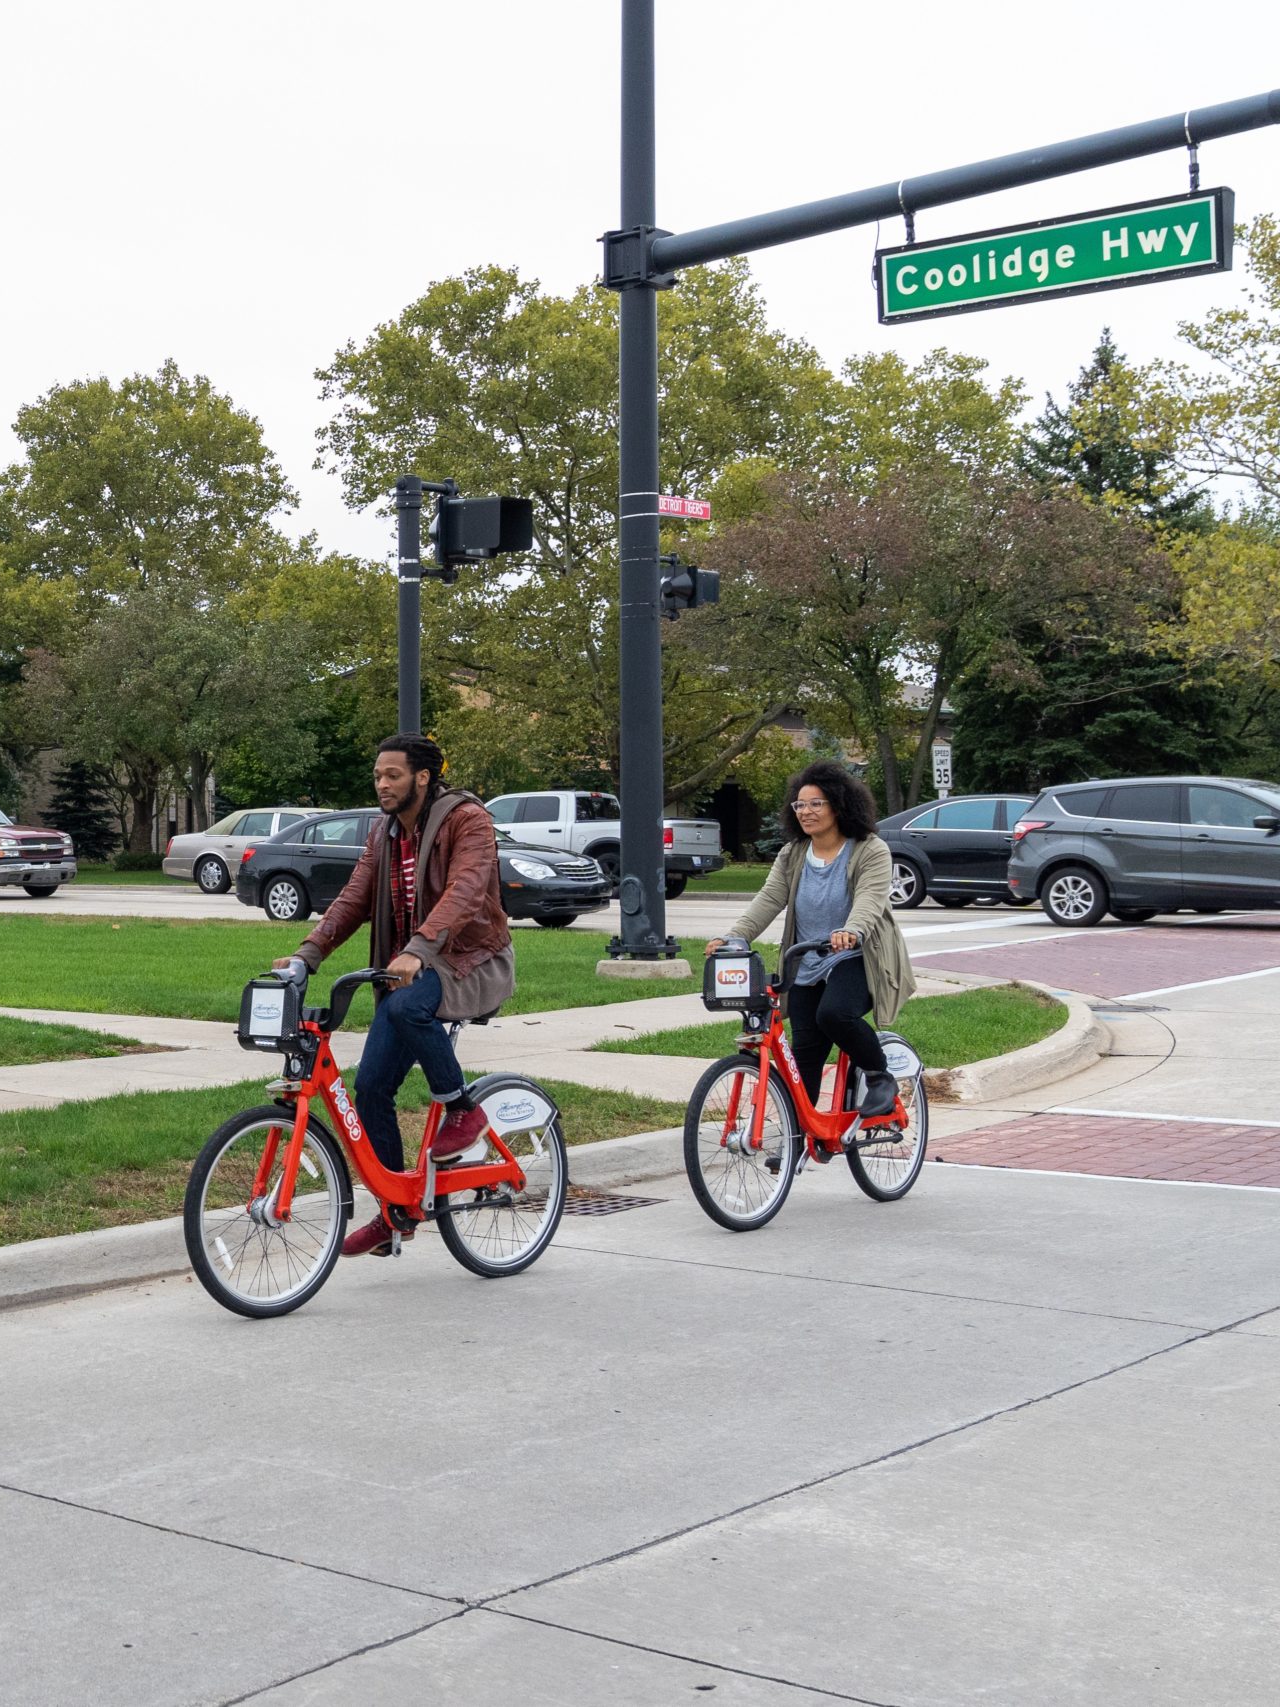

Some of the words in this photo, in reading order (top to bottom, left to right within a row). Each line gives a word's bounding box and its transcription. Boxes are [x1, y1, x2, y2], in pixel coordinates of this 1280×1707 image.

[895, 244, 1076, 296] Coolidge
[1102, 222, 1200, 262] Hwy
[659, 497, 684, 513] DETROIT
[684, 501, 705, 516] TIGERS
[936, 768, 950, 785] 35
[721, 970, 745, 986] hap
